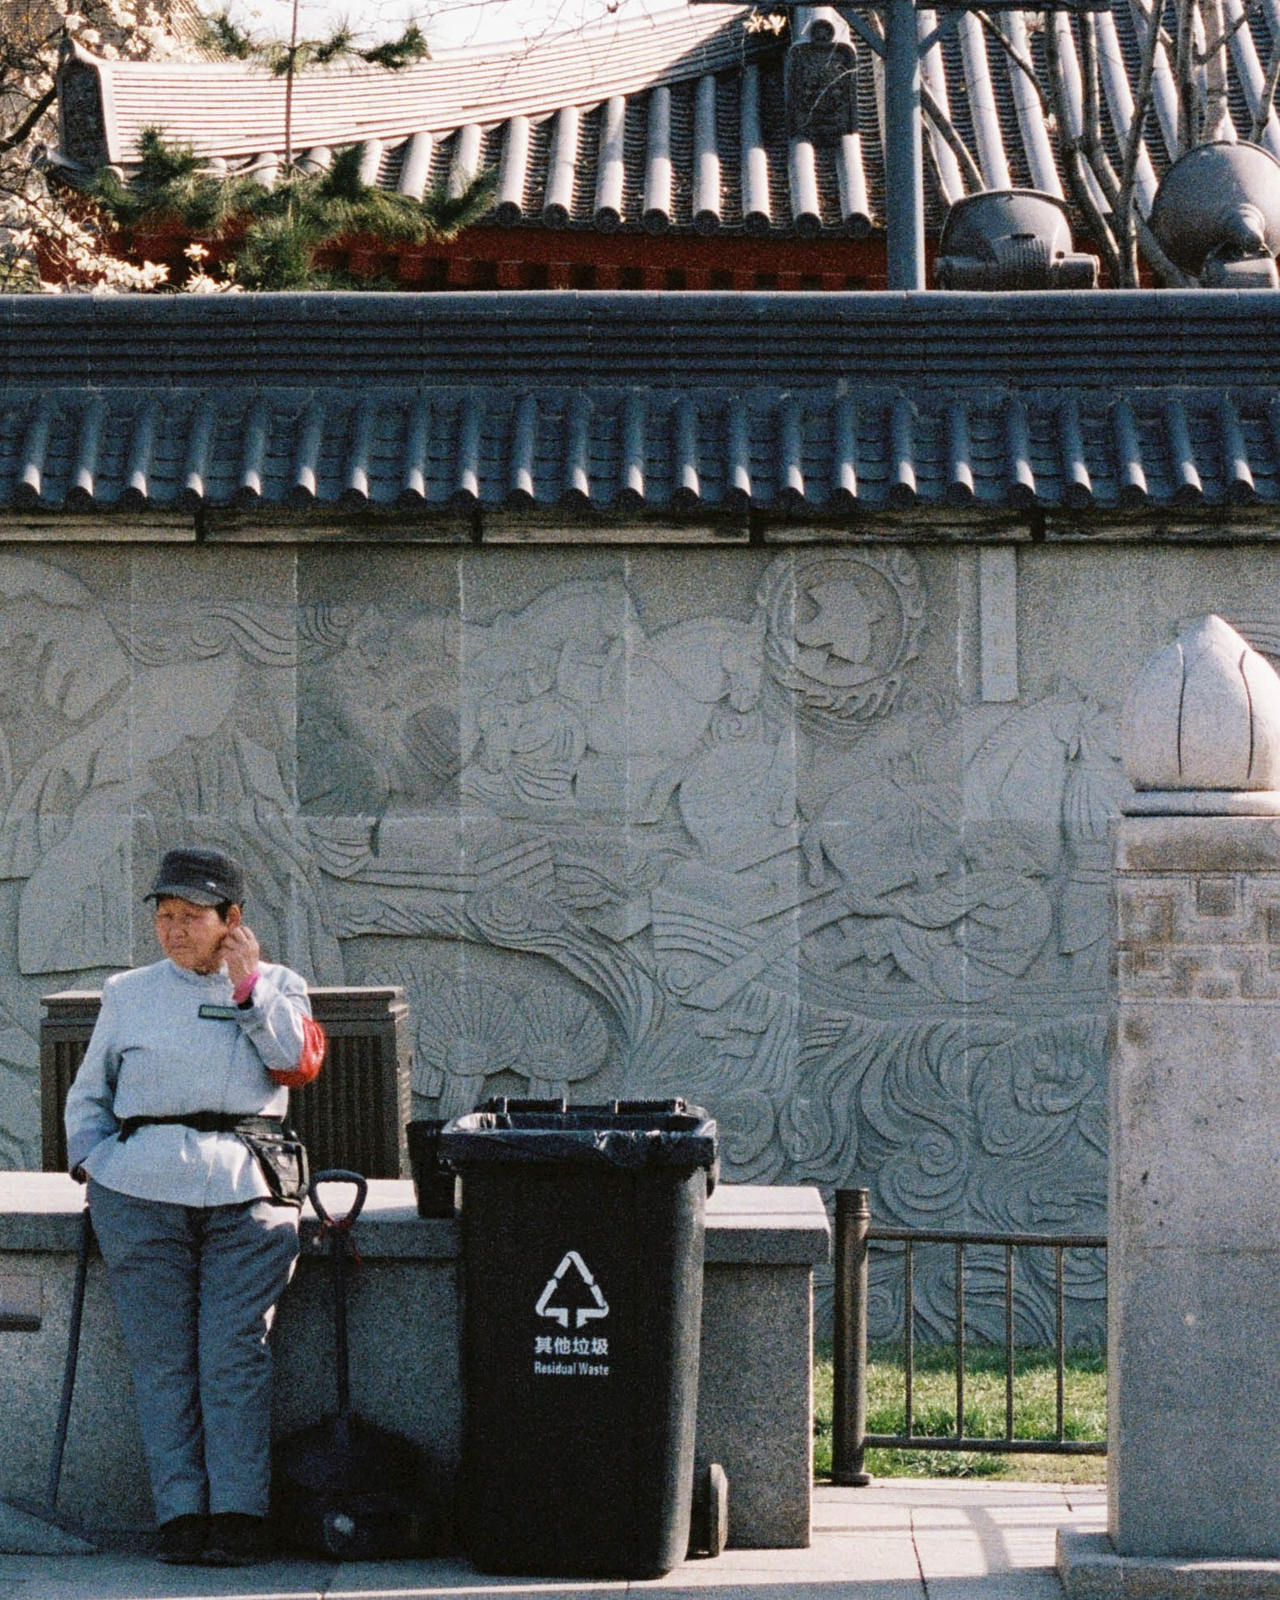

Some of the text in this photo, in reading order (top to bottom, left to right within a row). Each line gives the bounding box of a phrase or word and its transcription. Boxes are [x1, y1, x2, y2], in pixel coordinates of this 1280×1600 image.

[535, 1336, 608, 1355] 其他垃圾
[535, 1361, 609, 1376] Residual Waste
